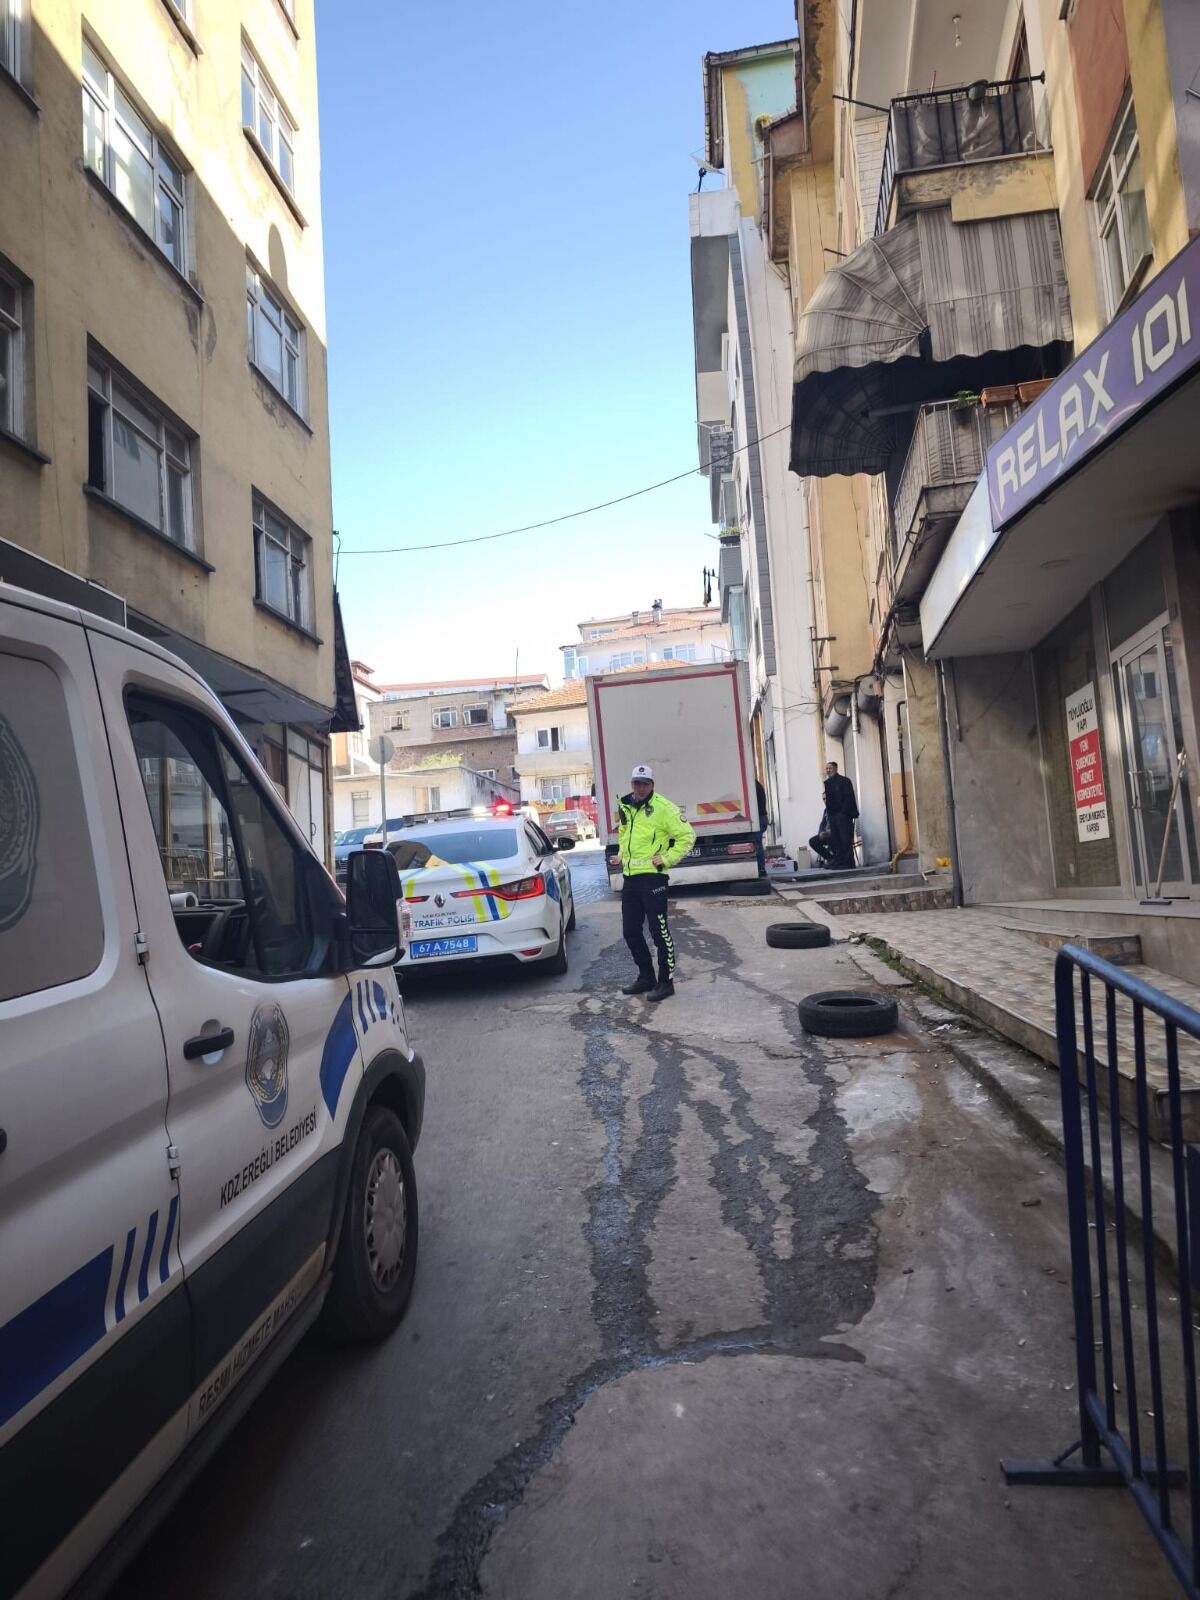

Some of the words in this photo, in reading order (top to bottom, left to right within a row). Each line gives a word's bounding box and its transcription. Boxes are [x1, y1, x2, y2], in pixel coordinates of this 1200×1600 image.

[996, 350, 1115, 513] RELAX
[419, 943, 430, 953] 67
[434, 942, 441, 951] A
[444, 939, 469, 950] 7548
[275, 1105, 317, 1162] BELEDİYESİ
